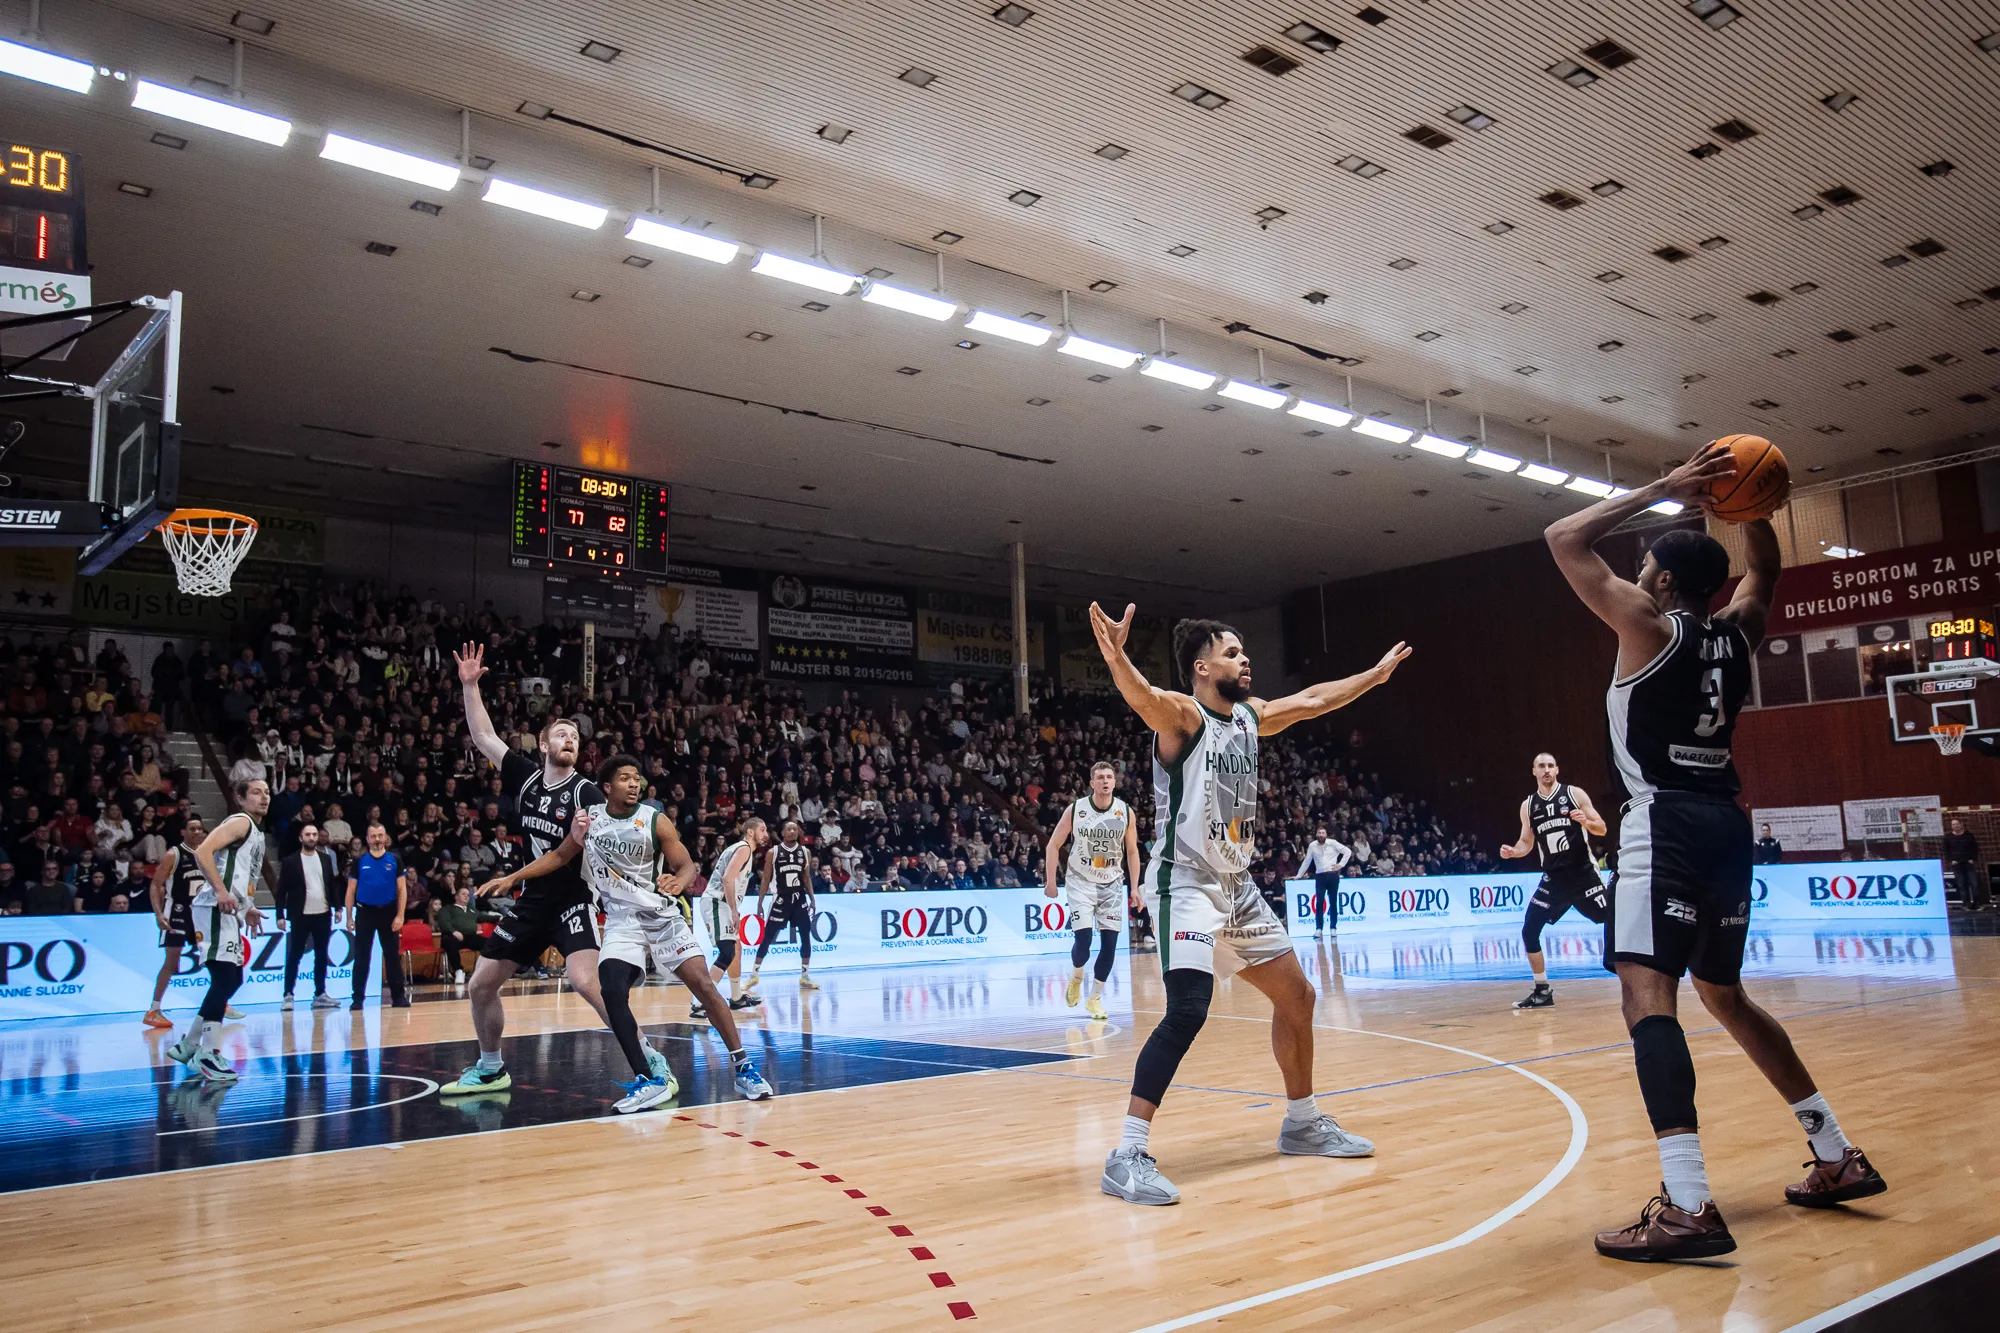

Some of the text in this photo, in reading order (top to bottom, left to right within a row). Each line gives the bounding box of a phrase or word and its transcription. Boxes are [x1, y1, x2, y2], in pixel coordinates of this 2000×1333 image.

[580, 478, 617, 497] 08:30
[0, 509, 61, 524] STEM
[568, 509, 585, 526] 77
[603, 505, 625, 513] HOSTIA
[609, 516, 626, 532] 62
[1832, 562, 1917, 589] ŠPORTOM
[1933, 556, 1955, 573] ZA
[84, 582, 217, 621] Majster
[810, 585, 907, 608] PRIEVIDZA
[1785, 590, 1893, 619] DEVELOPING
[1908, 576, 1980, 600] SPORTS
[927, 616, 986, 640] Majster
[1930, 619, 1975, 637] 08:30
[770, 660, 830, 675] MAJSTER
[834, 665, 850, 677] SR
[855, 667, 912, 681] 2015/2016
[1936, 680, 1973, 691] TIPOS
[1694, 668, 1726, 737] 3
[1233, 779, 1240, 808] 1
[538, 796, 551, 814] 12
[1546, 803, 1555, 816] 17
[1078, 828, 1123, 840] HANDLOV
[1092, 840, 1109, 852] 25
[1470, 885, 1523, 908] BOZPO
[1808, 874, 1927, 900] BOZPO
[1297, 891, 1365, 917] BOPO
[1389, 888, 1449, 912] BOZPO
[568, 915, 584, 934] 12
[881, 906, 987, 939] BOZPO
[36, 984, 85, 996] SLUŽBY
